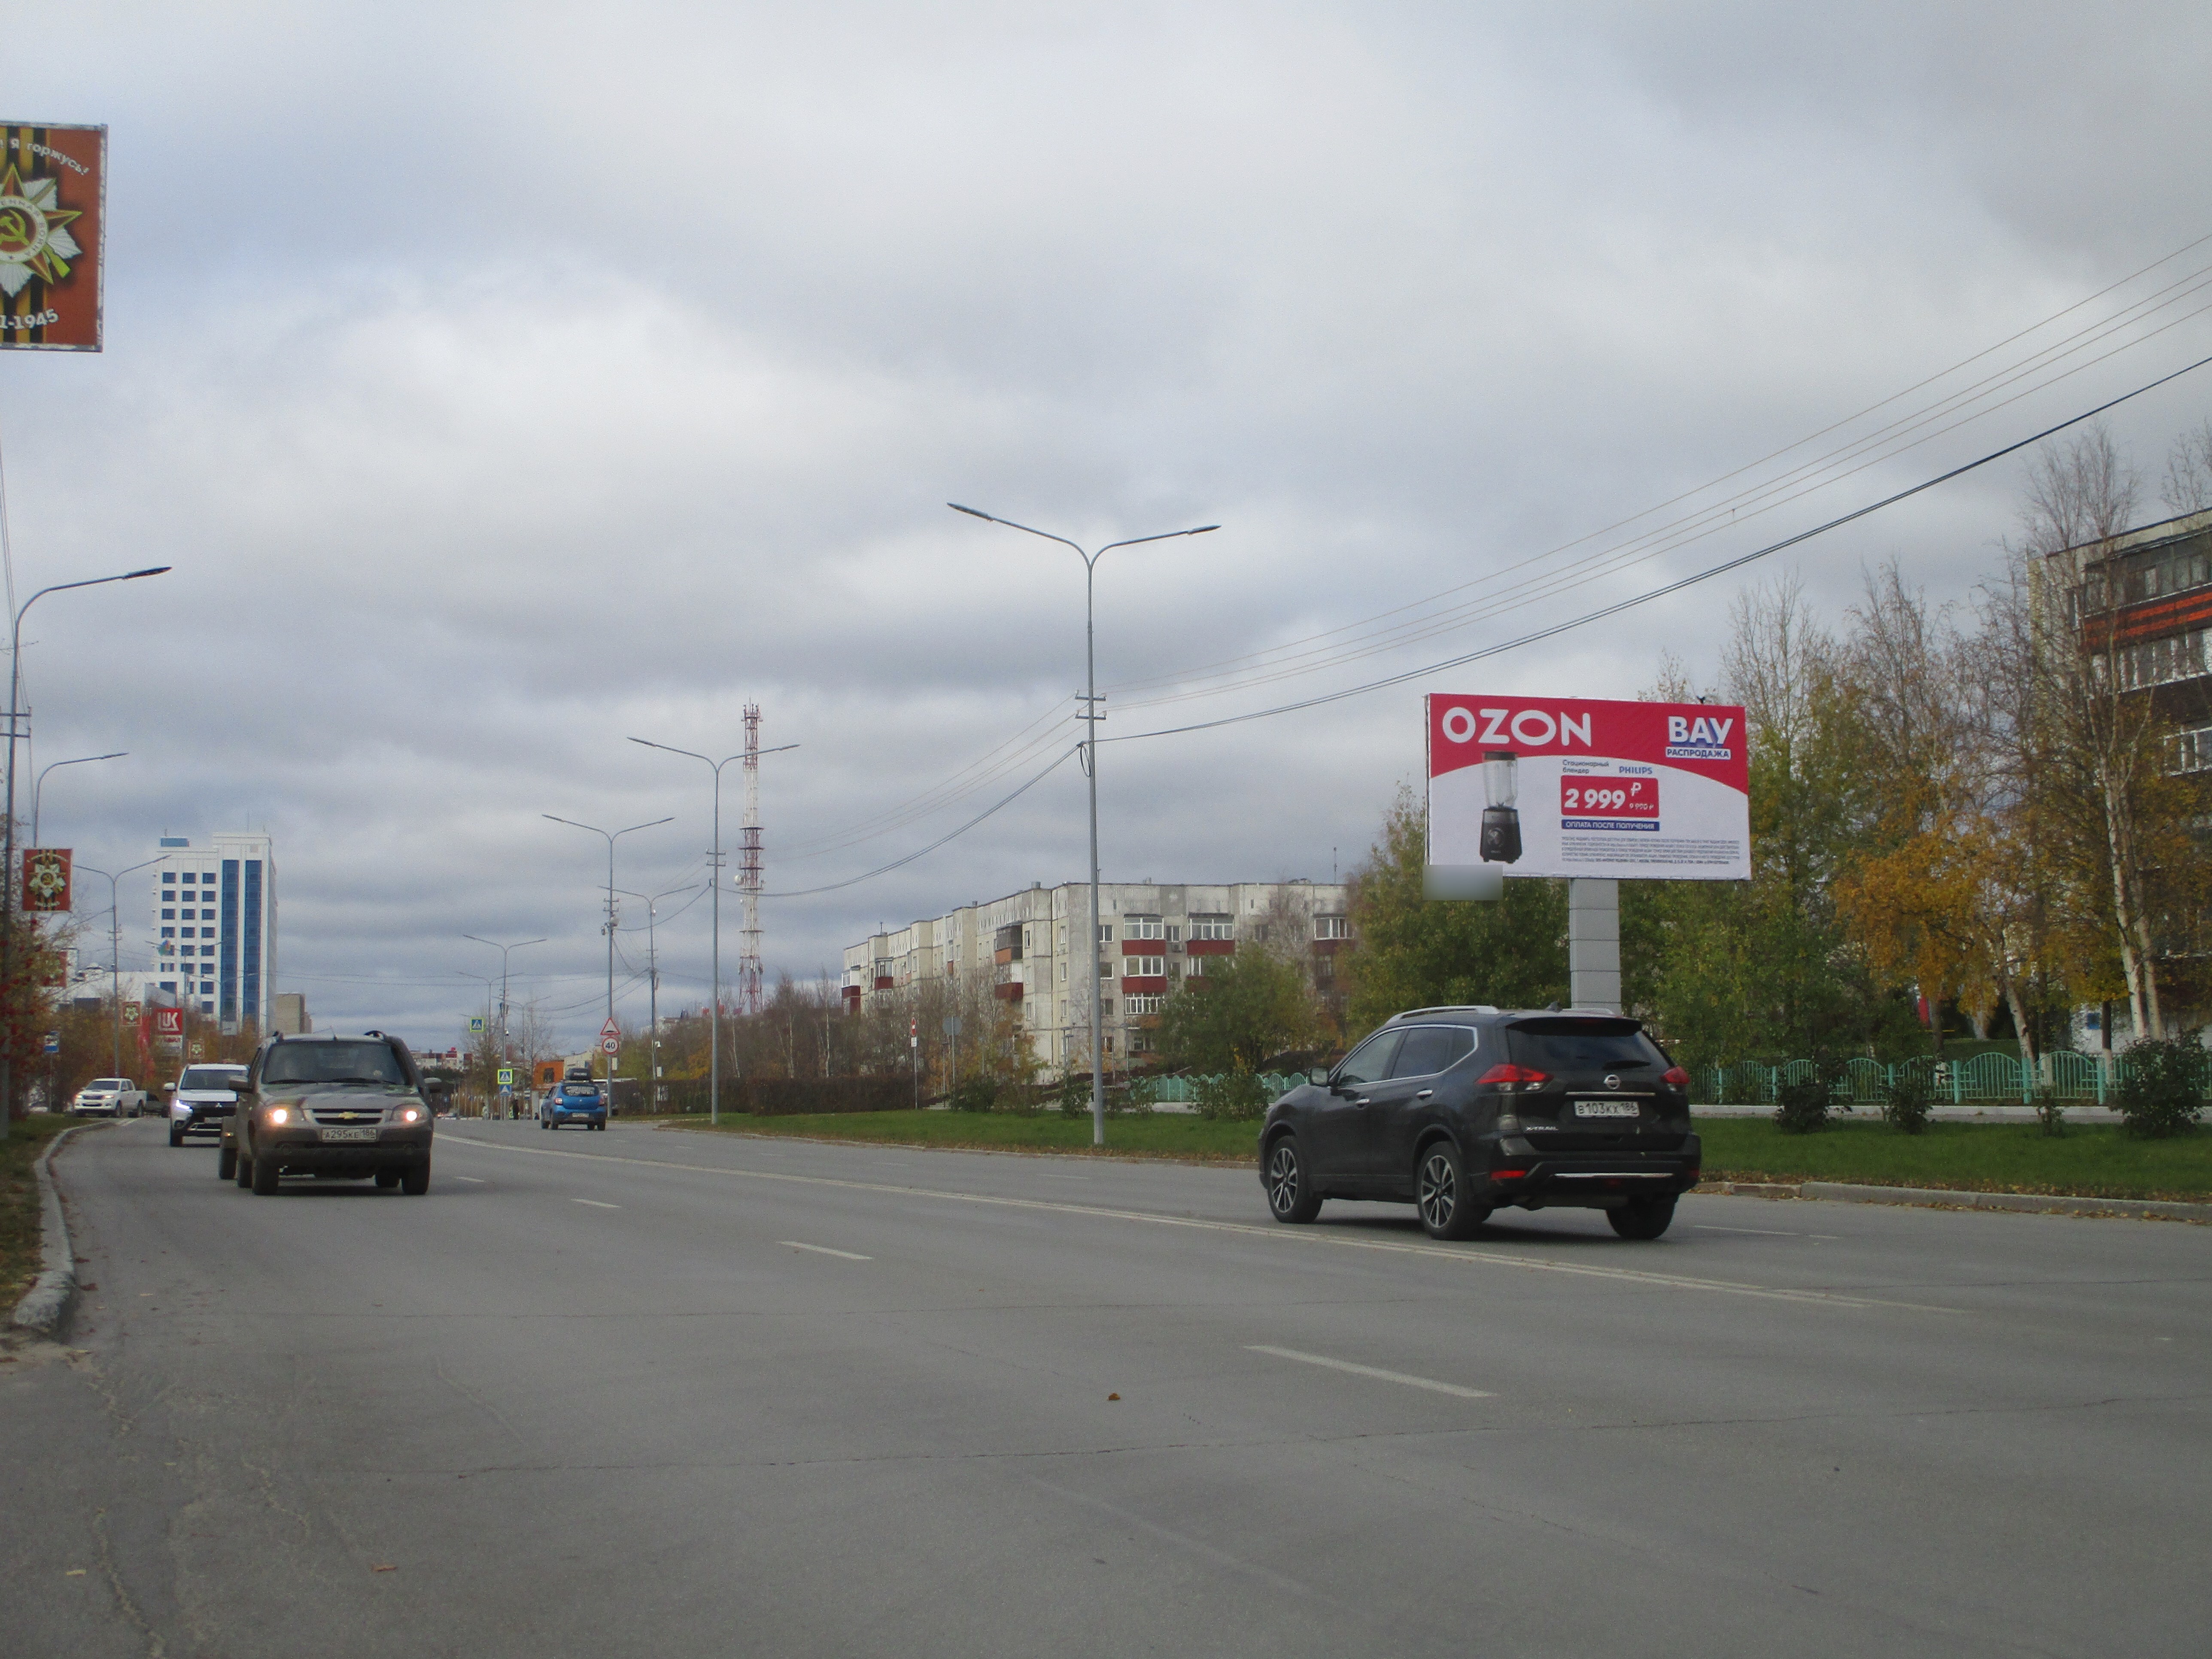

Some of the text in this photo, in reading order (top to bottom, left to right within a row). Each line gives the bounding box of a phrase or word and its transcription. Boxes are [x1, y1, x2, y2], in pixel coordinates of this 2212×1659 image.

[27, 143, 90, 176] горжусь!
[1442, 706, 1592, 747] OZON
[1667, 748, 1729, 758] РАСПРОДАЖА
[1563, 759, 1609, 767] Стационарный
[1619, 766, 1653, 775] PHILIPS
[1564, 788, 1580, 808] 2
[1584, 789, 1626, 809] 999
